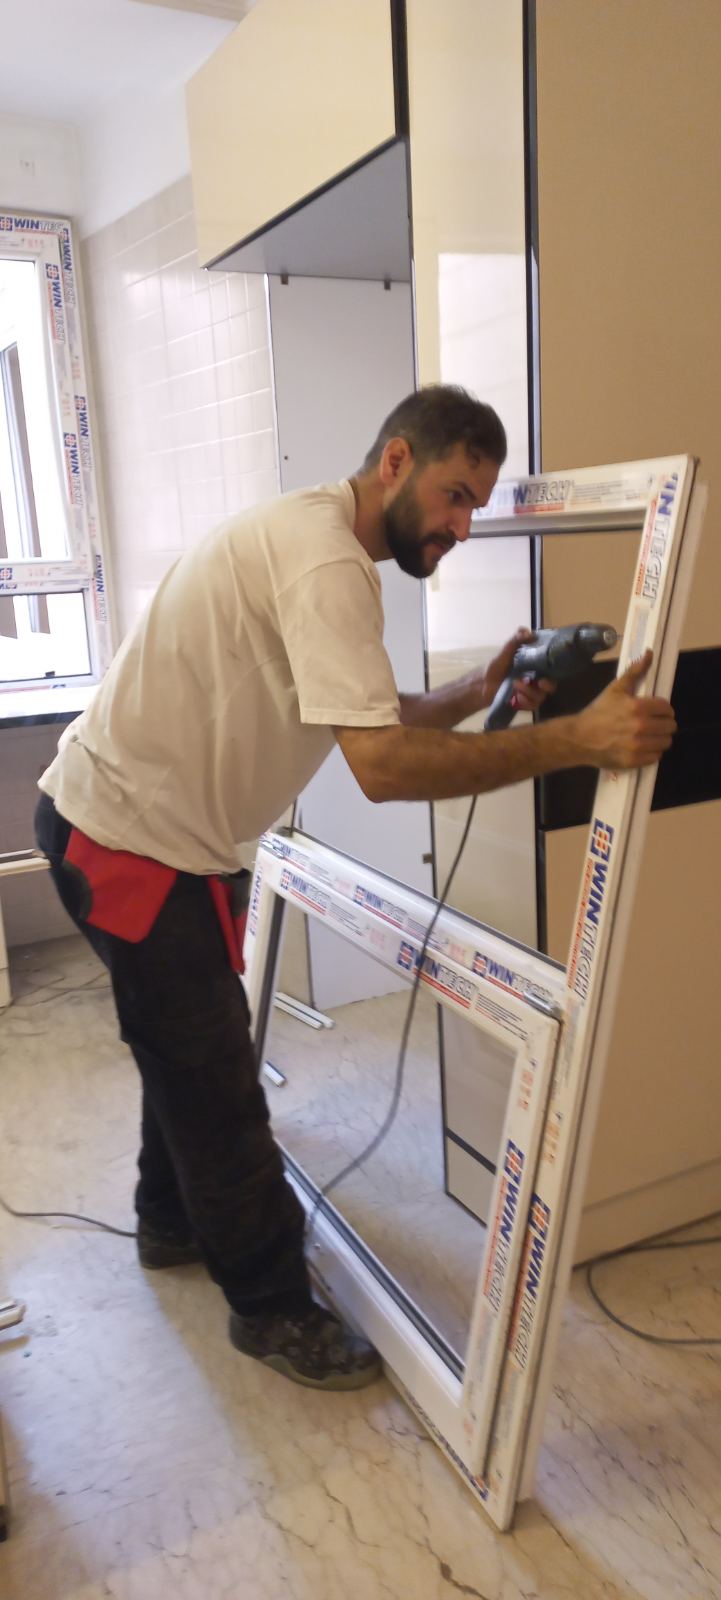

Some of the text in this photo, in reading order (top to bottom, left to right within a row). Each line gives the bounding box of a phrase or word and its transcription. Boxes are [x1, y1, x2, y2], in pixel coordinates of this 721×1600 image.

[574, 861, 608, 1000] WINTECH
[486, 1177, 520, 1314] WINTECH
[513, 1237, 547, 1370] WINTECH
